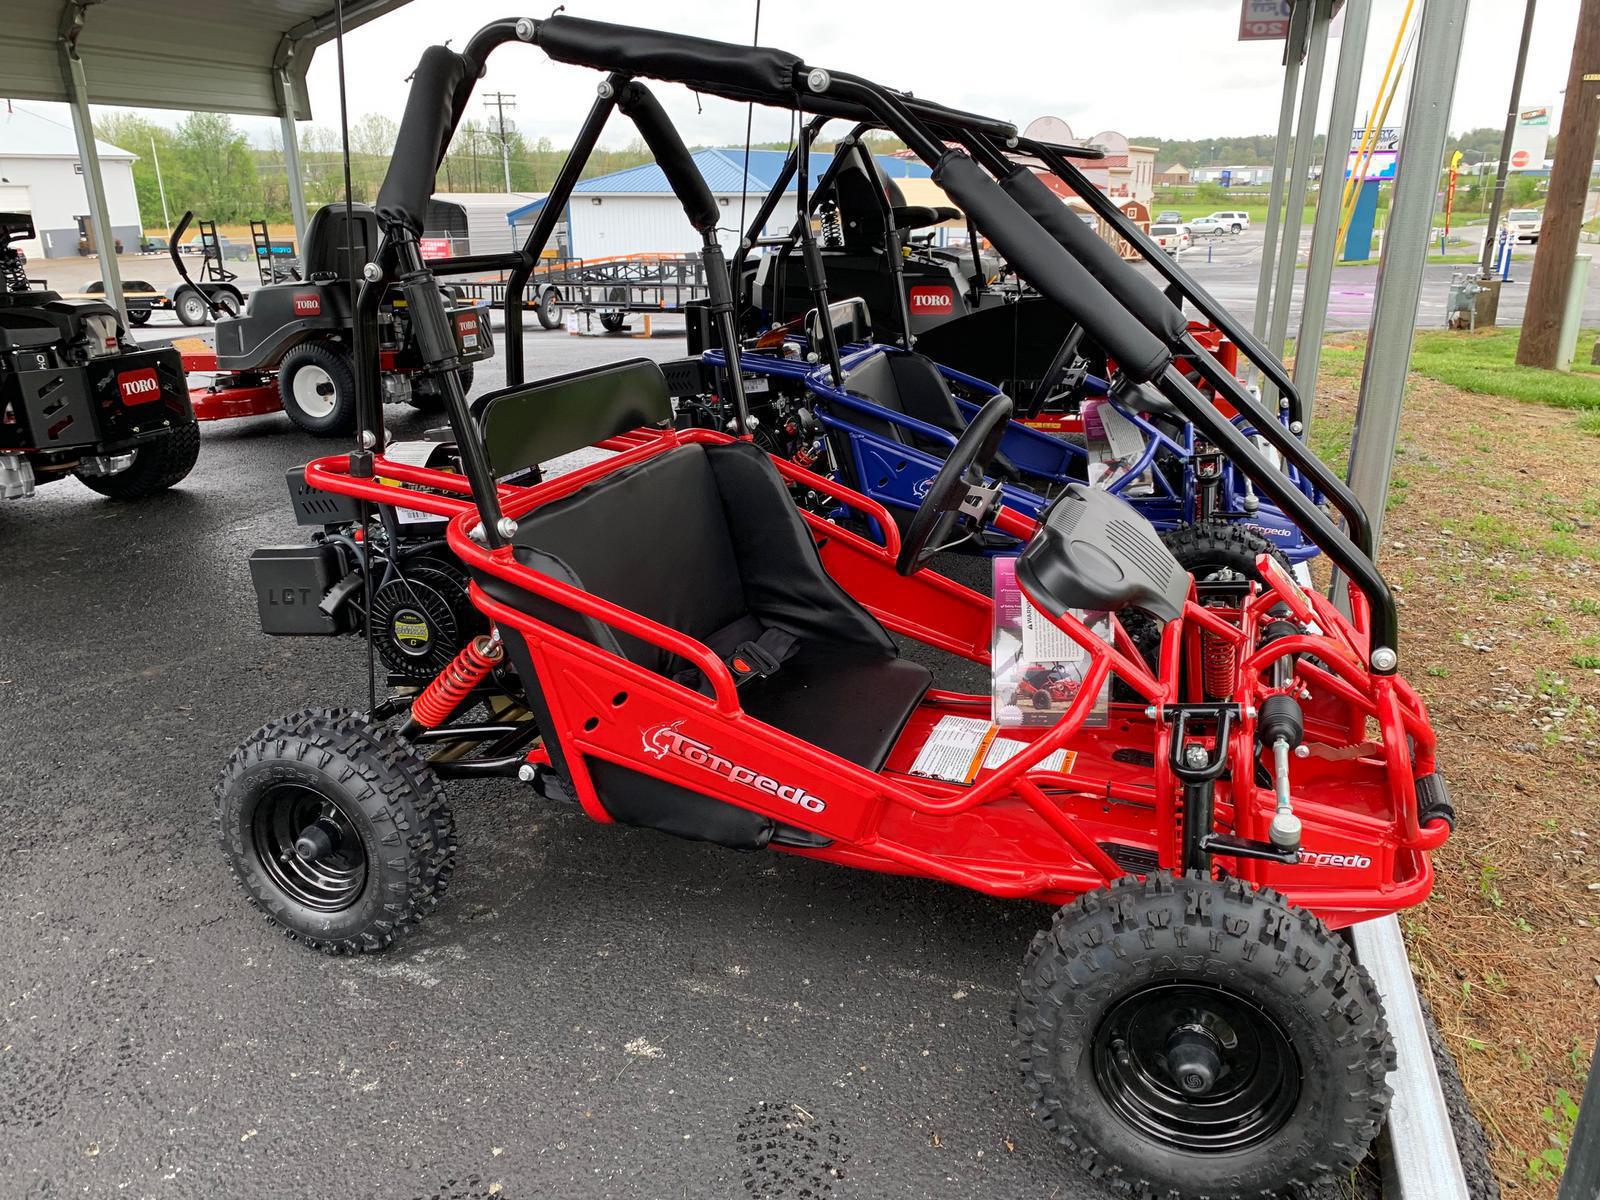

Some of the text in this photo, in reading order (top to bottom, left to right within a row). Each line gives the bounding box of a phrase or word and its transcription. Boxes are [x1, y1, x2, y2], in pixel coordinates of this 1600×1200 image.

[295, 300, 320, 309] TORO
[913, 295, 951, 306] TORO
[459, 320, 478, 331] TORO
[122, 377, 158, 396] TORO
[662, 728, 827, 814] Torpedo
[1298, 847, 1372, 869] rpedo
